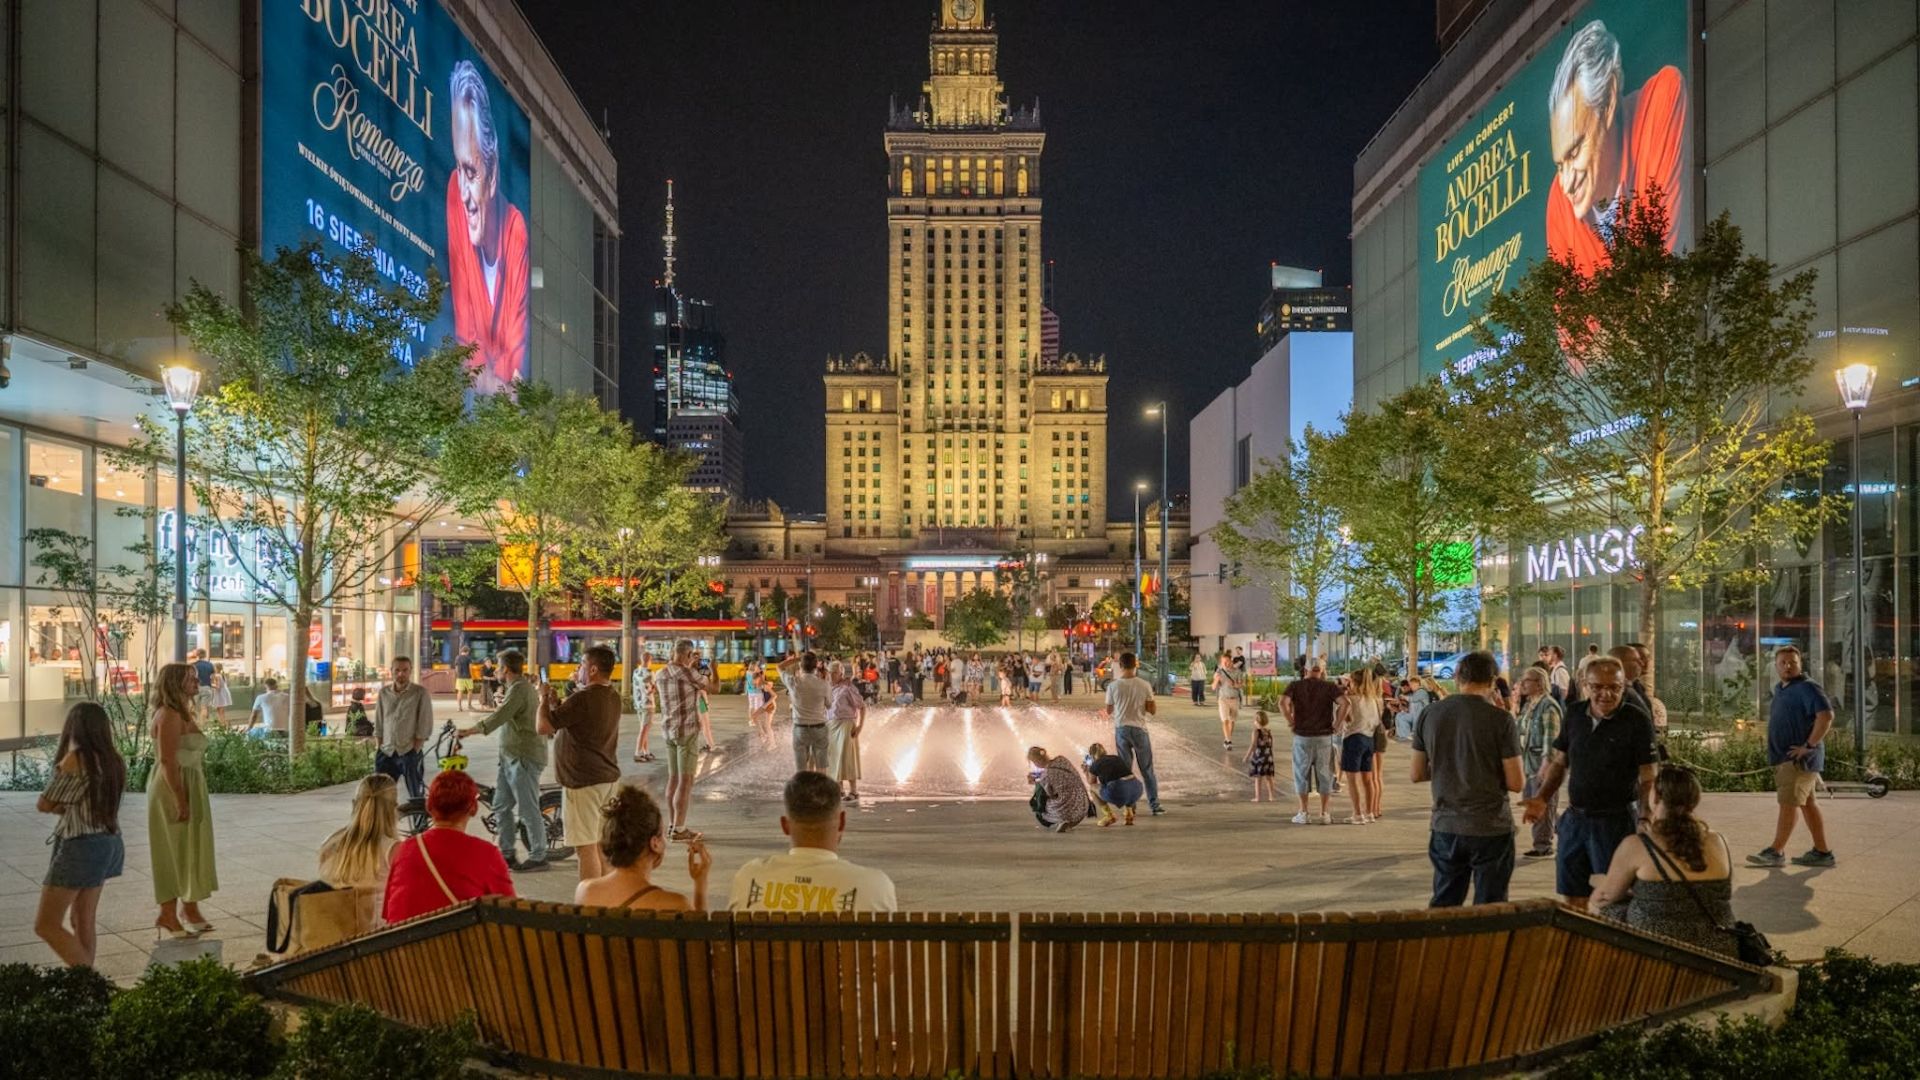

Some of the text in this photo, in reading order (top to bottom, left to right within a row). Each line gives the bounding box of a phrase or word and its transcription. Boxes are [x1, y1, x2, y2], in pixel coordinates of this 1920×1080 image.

[313, 63, 425, 201] Romanza
[1446, 101, 1515, 174] LIVE IN CONCERT
[1435, 150, 1531, 264] BOCELLI
[1444, 128, 1518, 218] ANDREA
[306, 198, 325, 231] 16
[1443, 231, 1522, 317] Romanza
[763, 881, 838, 912] USYK
[795, 875, 812, 884] TEAM
